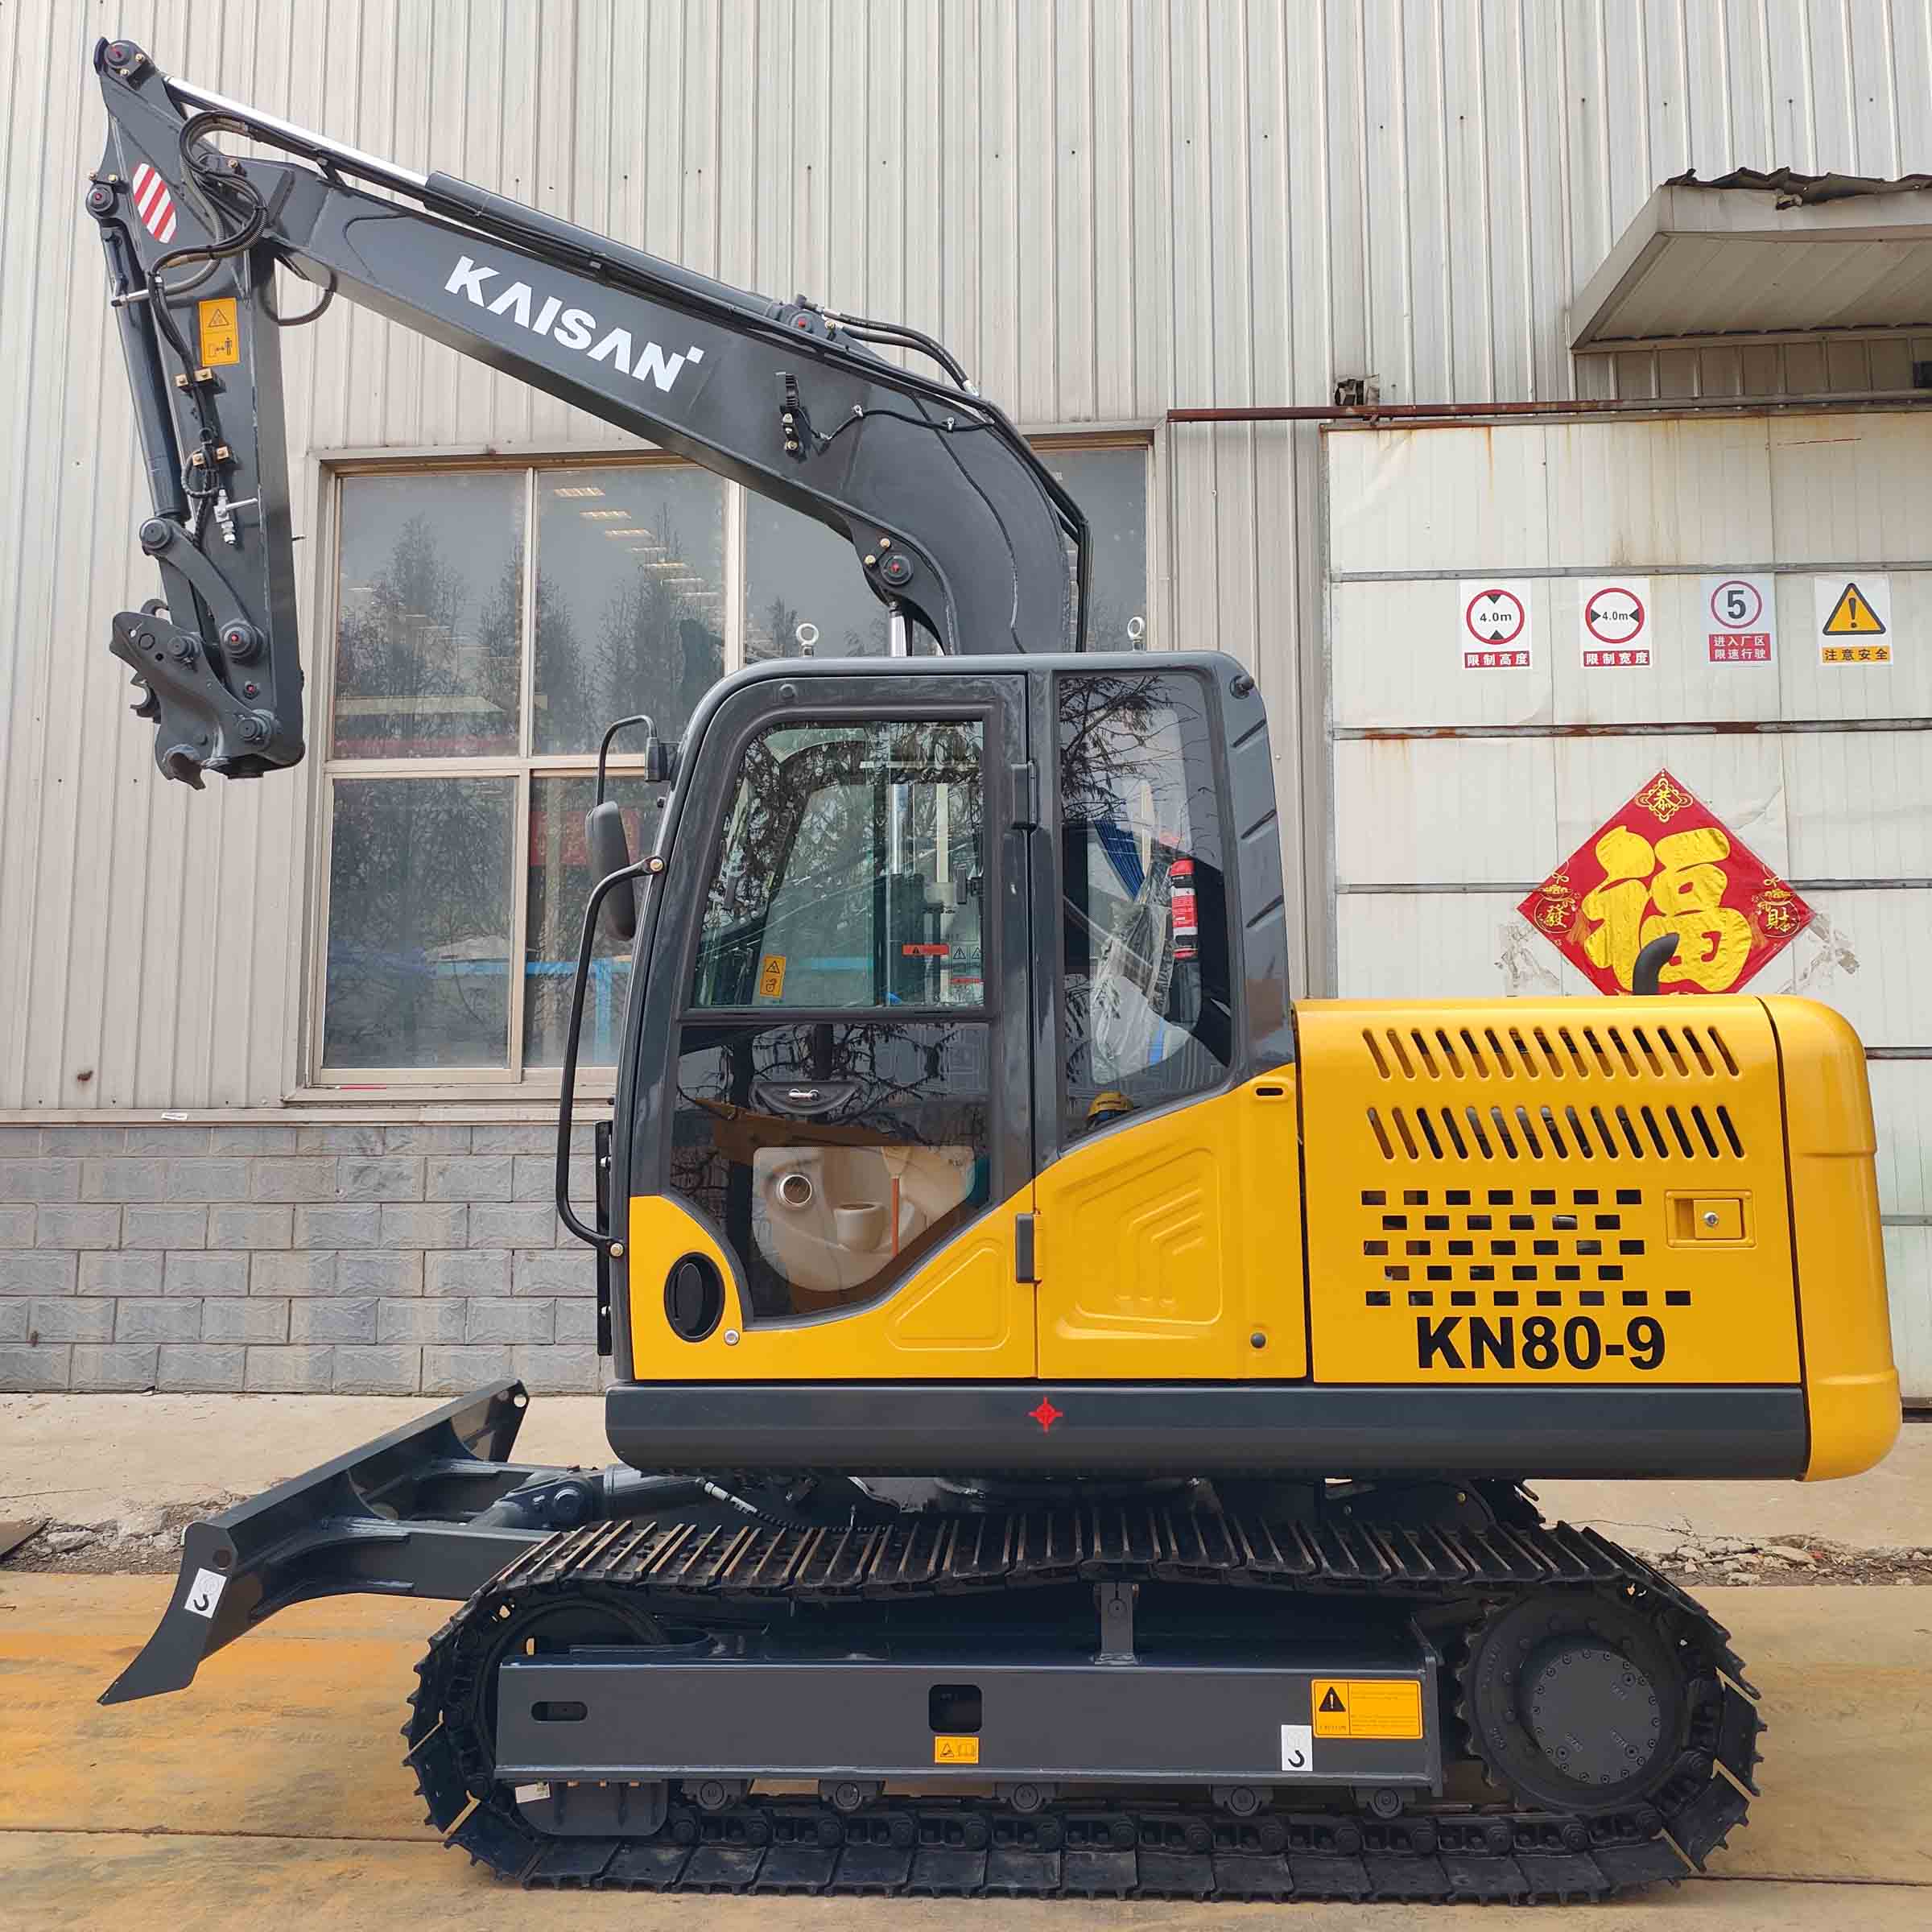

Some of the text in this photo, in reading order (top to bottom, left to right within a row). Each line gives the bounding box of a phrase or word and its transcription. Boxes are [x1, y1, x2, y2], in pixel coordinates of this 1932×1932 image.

[444, 256, 704, 393] KAISAN
[1728, 590, 1746, 619] 5
[1480, 612, 1512, 622] 4.0m
[1602, 611, 1629, 621] 4.0m
[1714, 636, 1765, 646] 进入厂区
[1468, 653, 1527, 667] 限制高度
[1586, 652, 1648, 665] 限制宽度
[1715, 648, 1765, 659] 限速行驶
[1824, 648, 1888, 661] 注意安全
[1653, 789, 1675, 811] 恭
[1582, 826, 1752, 992] 福
[1417, 1316, 1666, 1369] KN80-9
